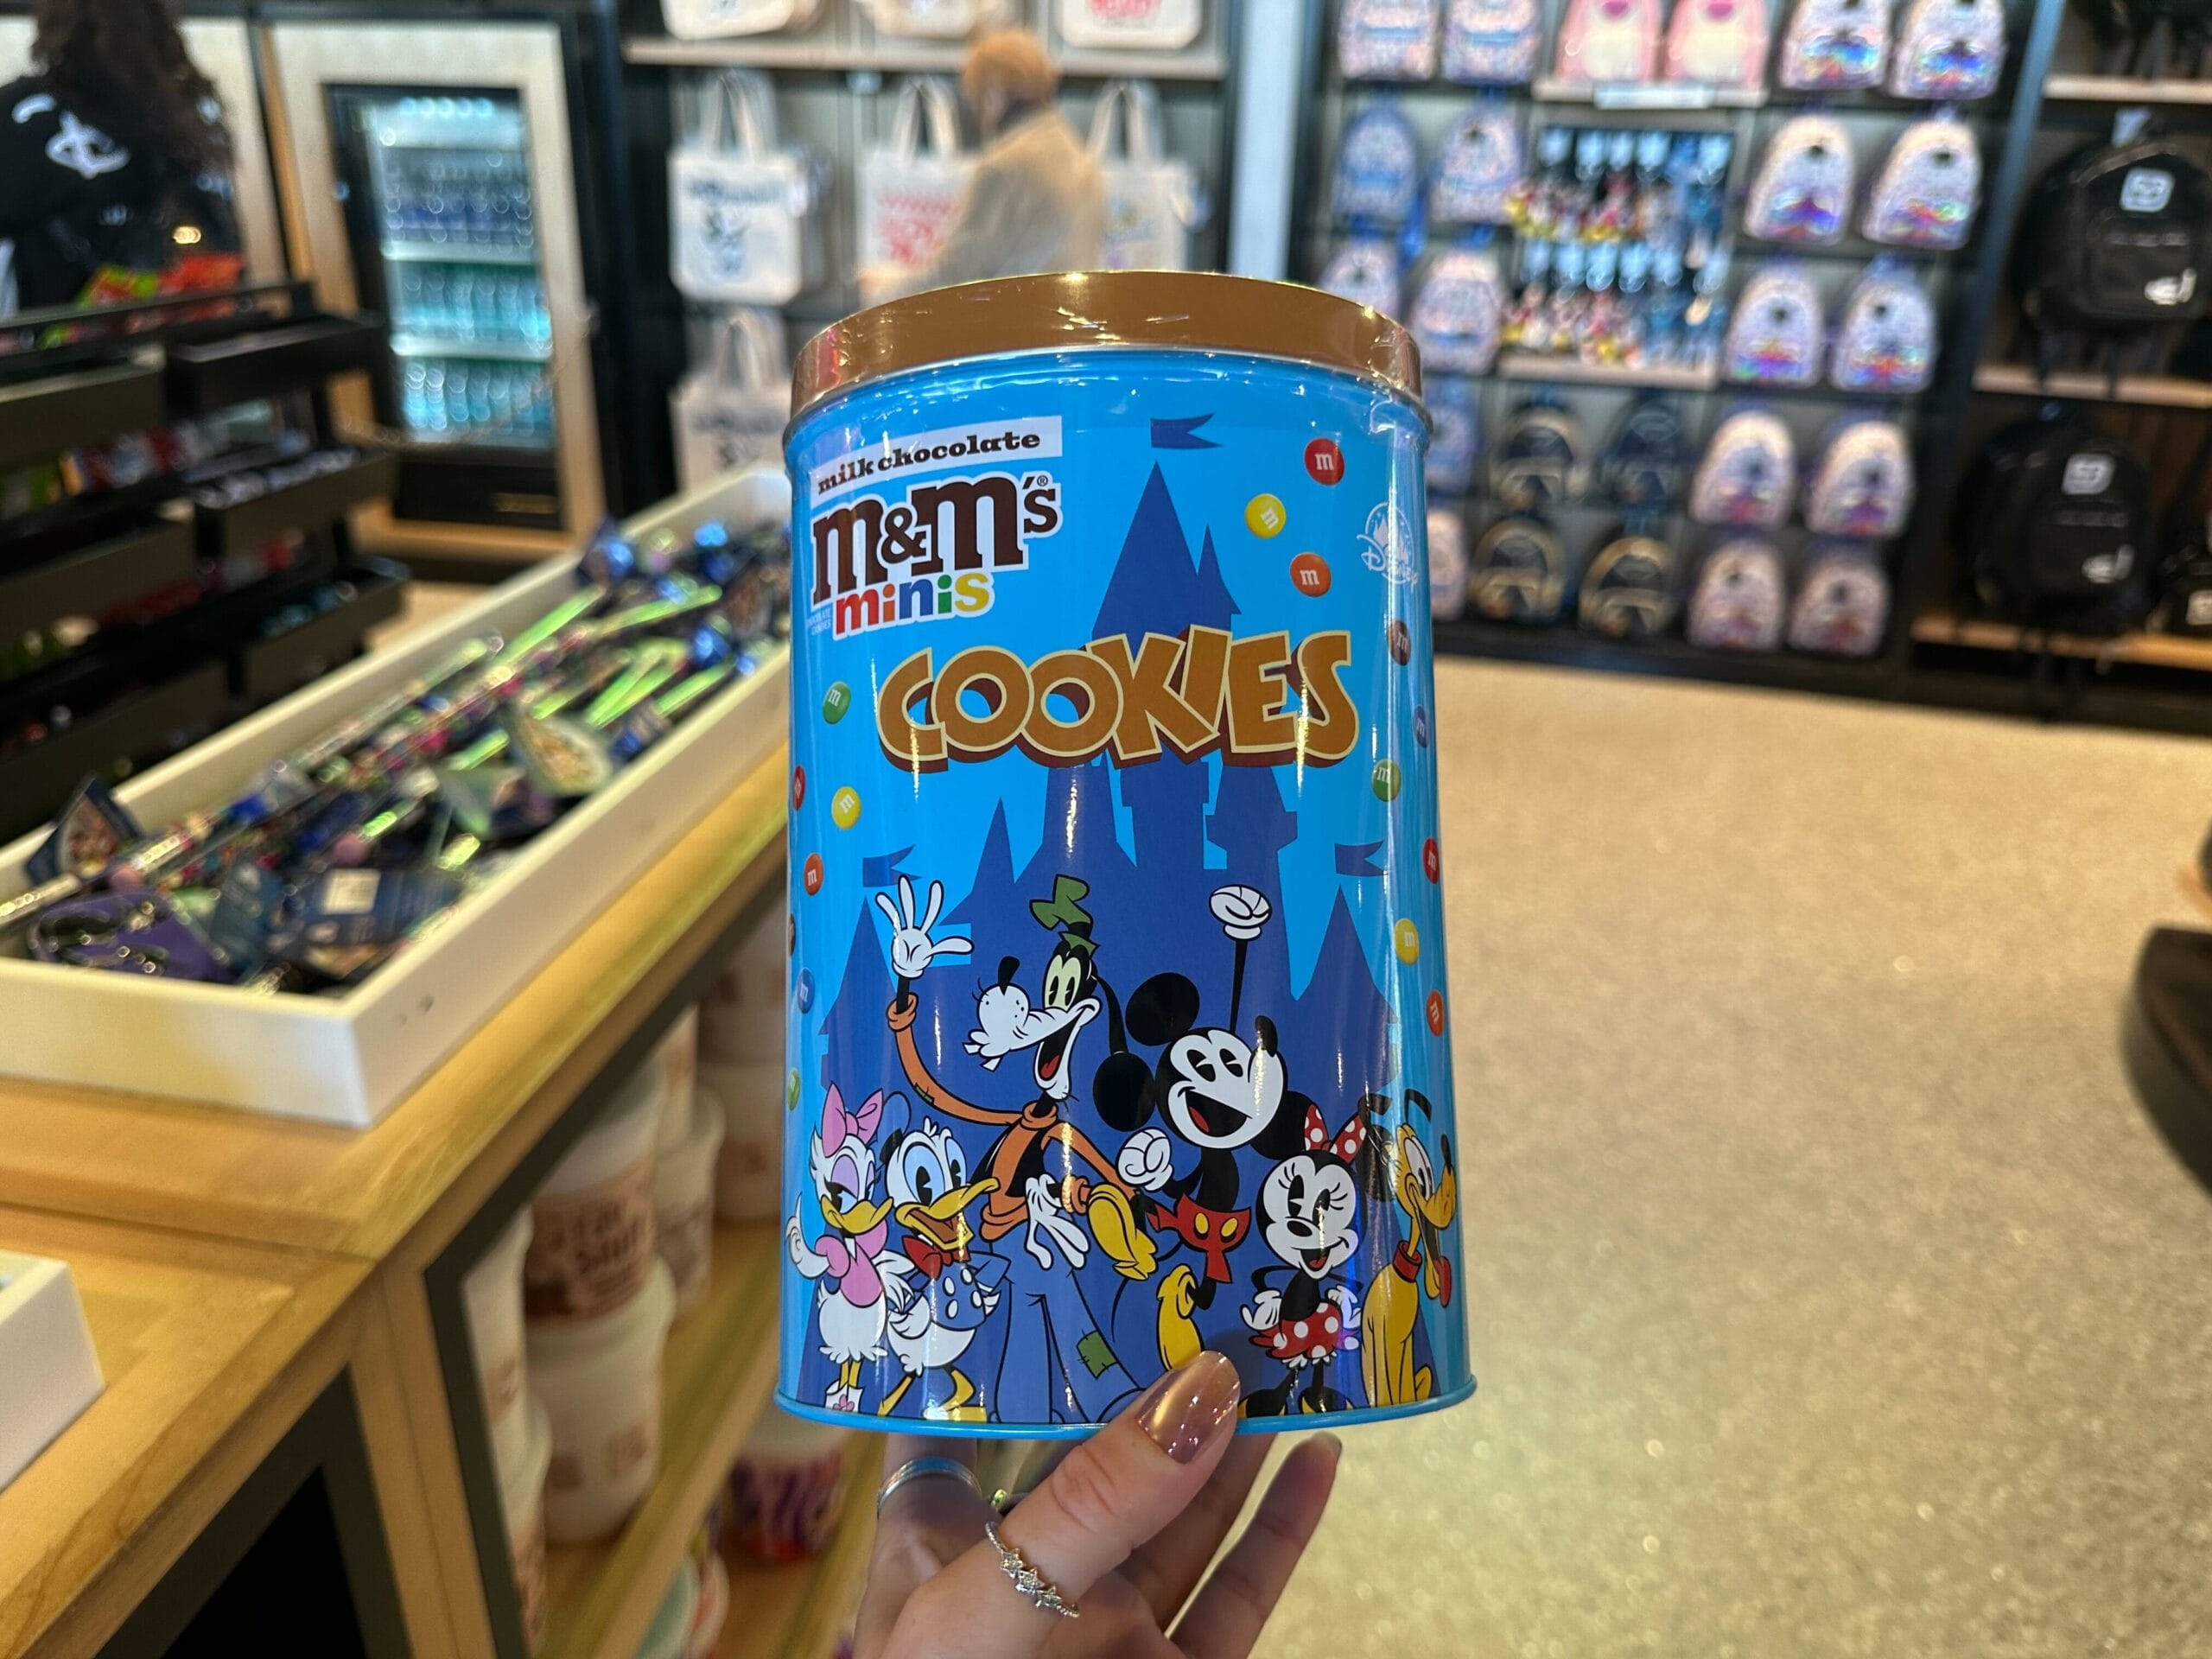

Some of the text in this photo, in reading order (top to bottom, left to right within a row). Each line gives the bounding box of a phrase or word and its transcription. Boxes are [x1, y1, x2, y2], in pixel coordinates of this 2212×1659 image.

[817, 431, 1041, 495] milk chocolate
[836, 572, 990, 635] minis
[876, 624, 1360, 772] COOKIES
